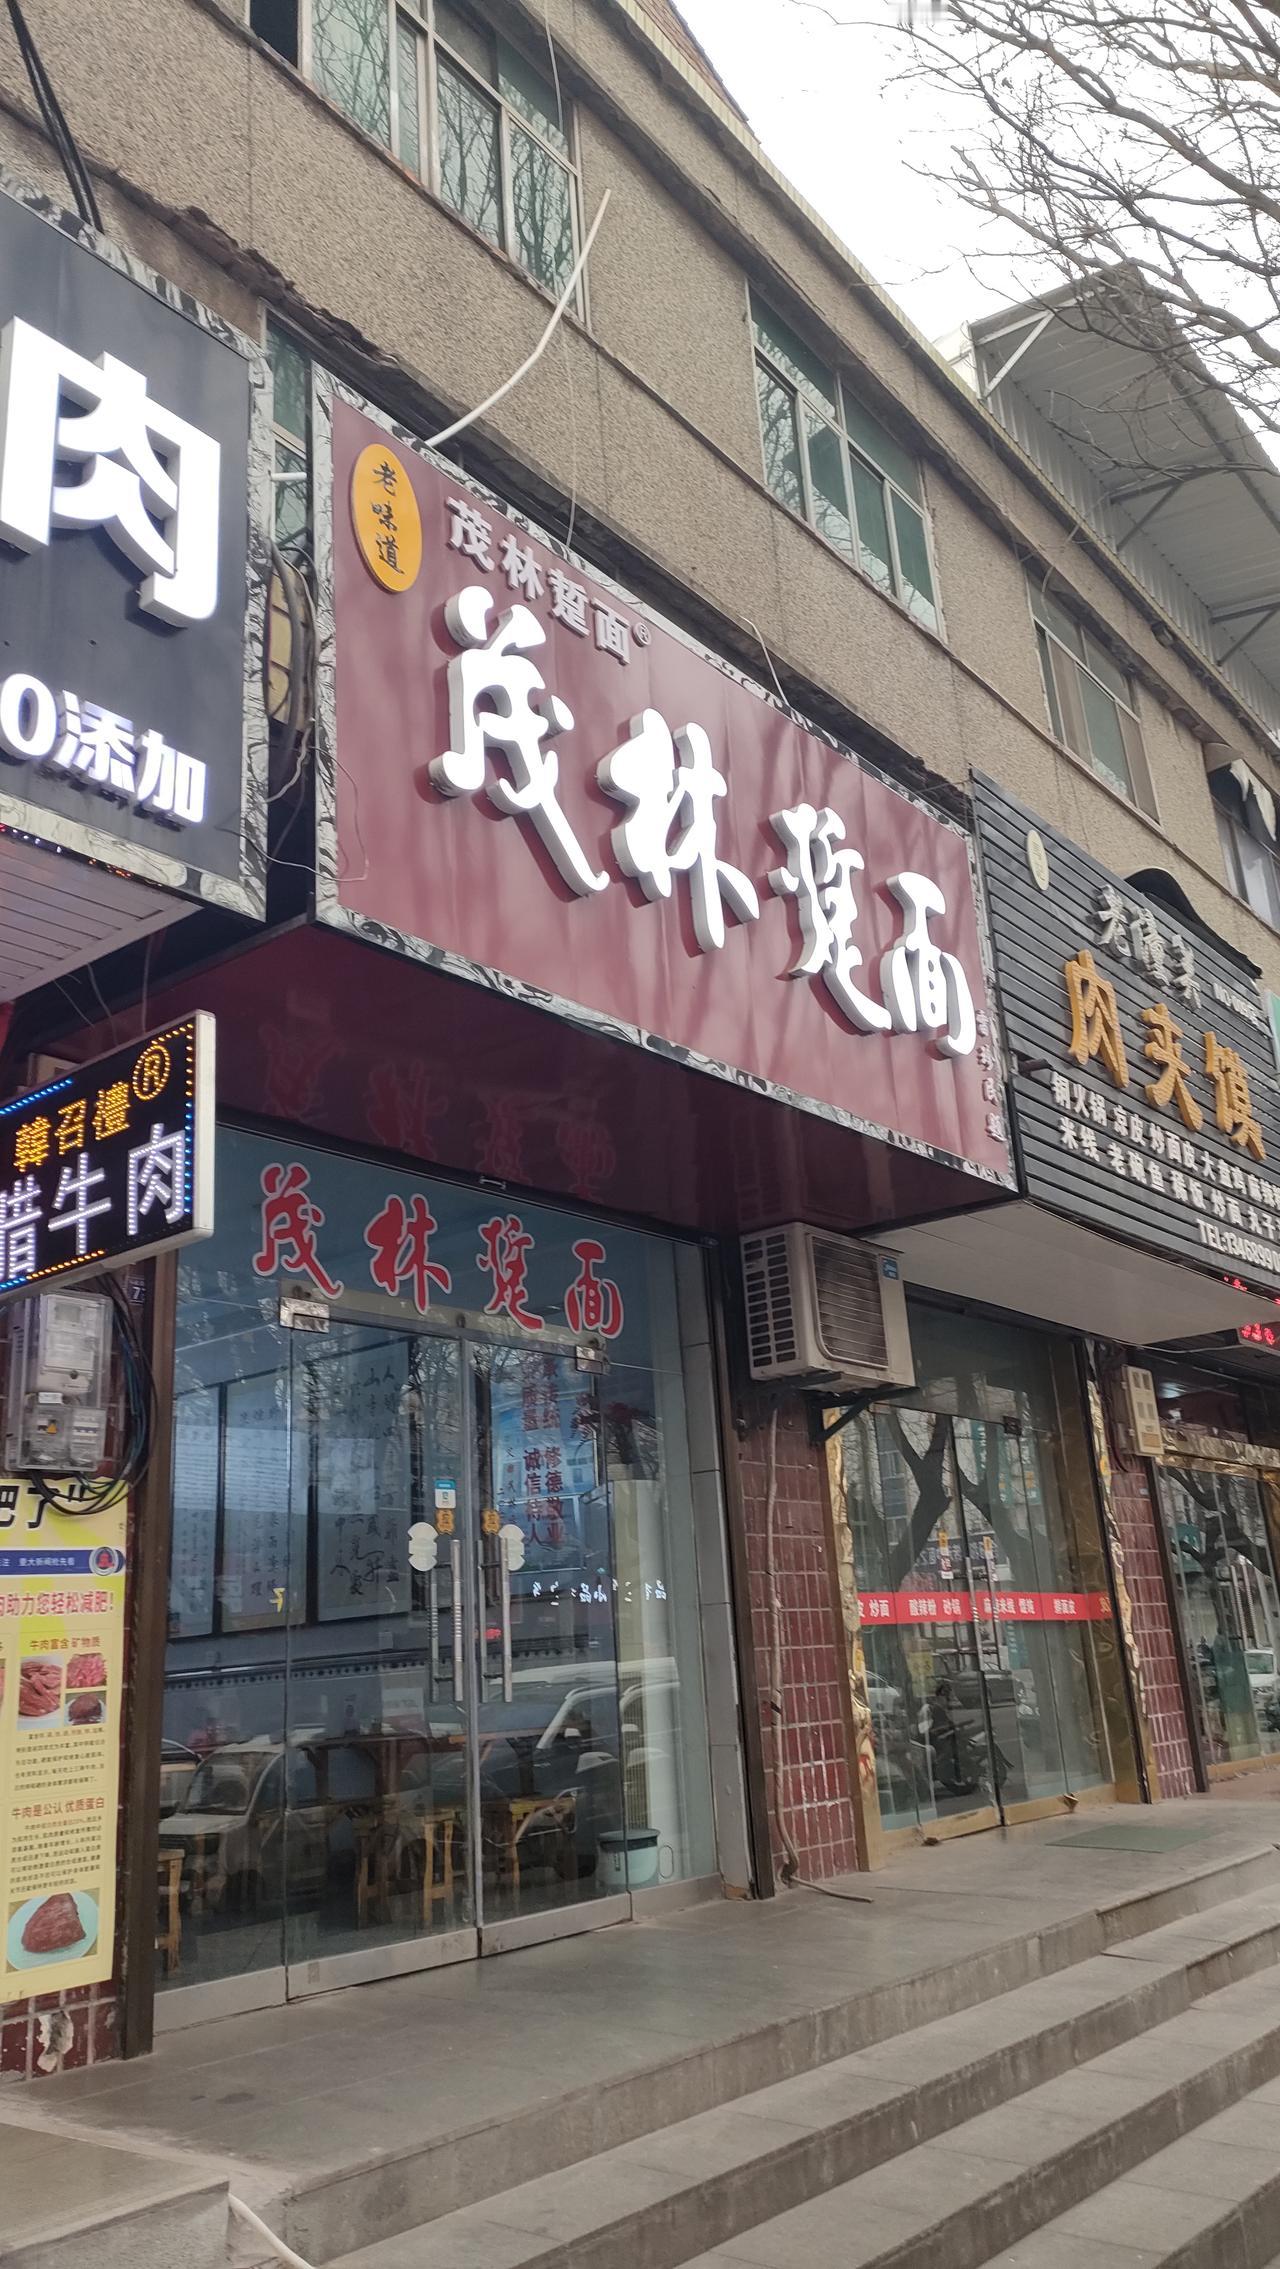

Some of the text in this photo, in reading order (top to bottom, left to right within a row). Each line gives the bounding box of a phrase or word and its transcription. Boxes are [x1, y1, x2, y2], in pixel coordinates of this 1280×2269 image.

[0, 316, 221, 627] 肉
[0, 671, 209, 824] 0添加
[1066, 949, 1267, 1161] 肉夹馍
[1050, 1071, 1108, 1127] 铜火锅
[1113, 1104, 1146, 1147] 凉皮
[1149, 1122, 1199, 1172] 炒面皮
[1200, 1150, 1247, 1196] 大盘鸡
[1059, 1116, 1100, 1162] 米线
[1107, 1141, 1166, 1193] 老碗鱼
[1210, 1187, 1244, 1228] 炒面
[10, 1796, 104, 1820] 牛肉是公认 优质蛋白
